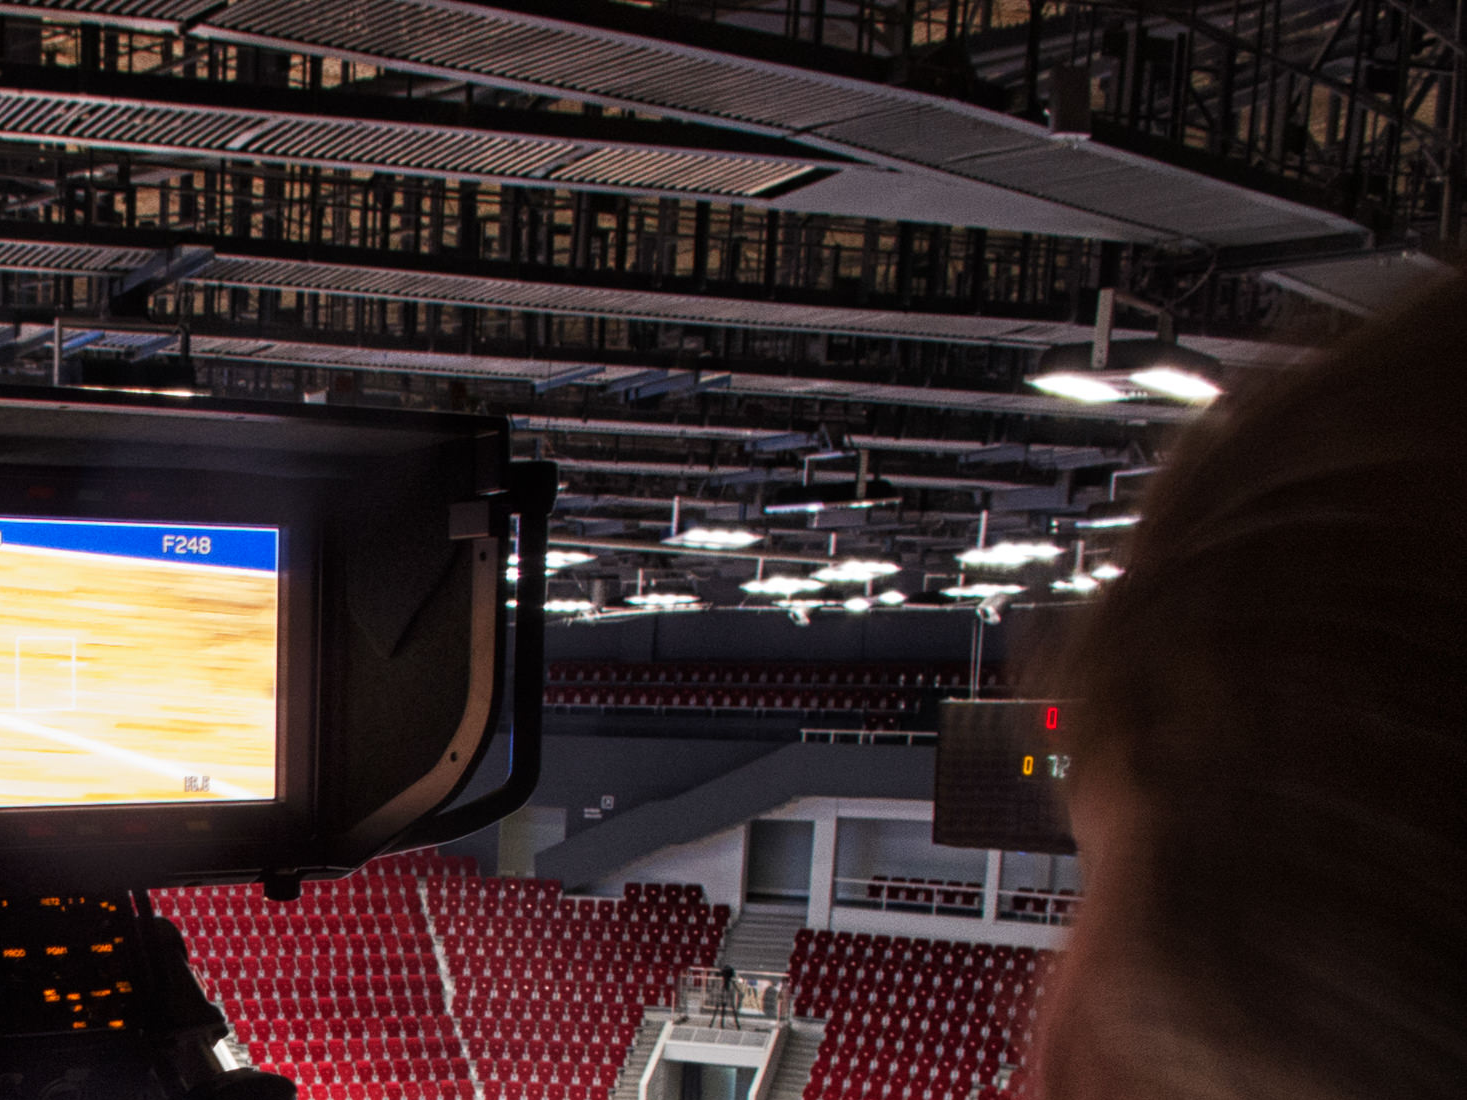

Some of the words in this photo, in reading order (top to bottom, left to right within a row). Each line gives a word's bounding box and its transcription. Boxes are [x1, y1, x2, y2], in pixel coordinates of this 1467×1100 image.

[162, 535, 212, 555] F248
[1046, 707, 1058, 729] 0
[1022, 755, 1034, 775] 0
